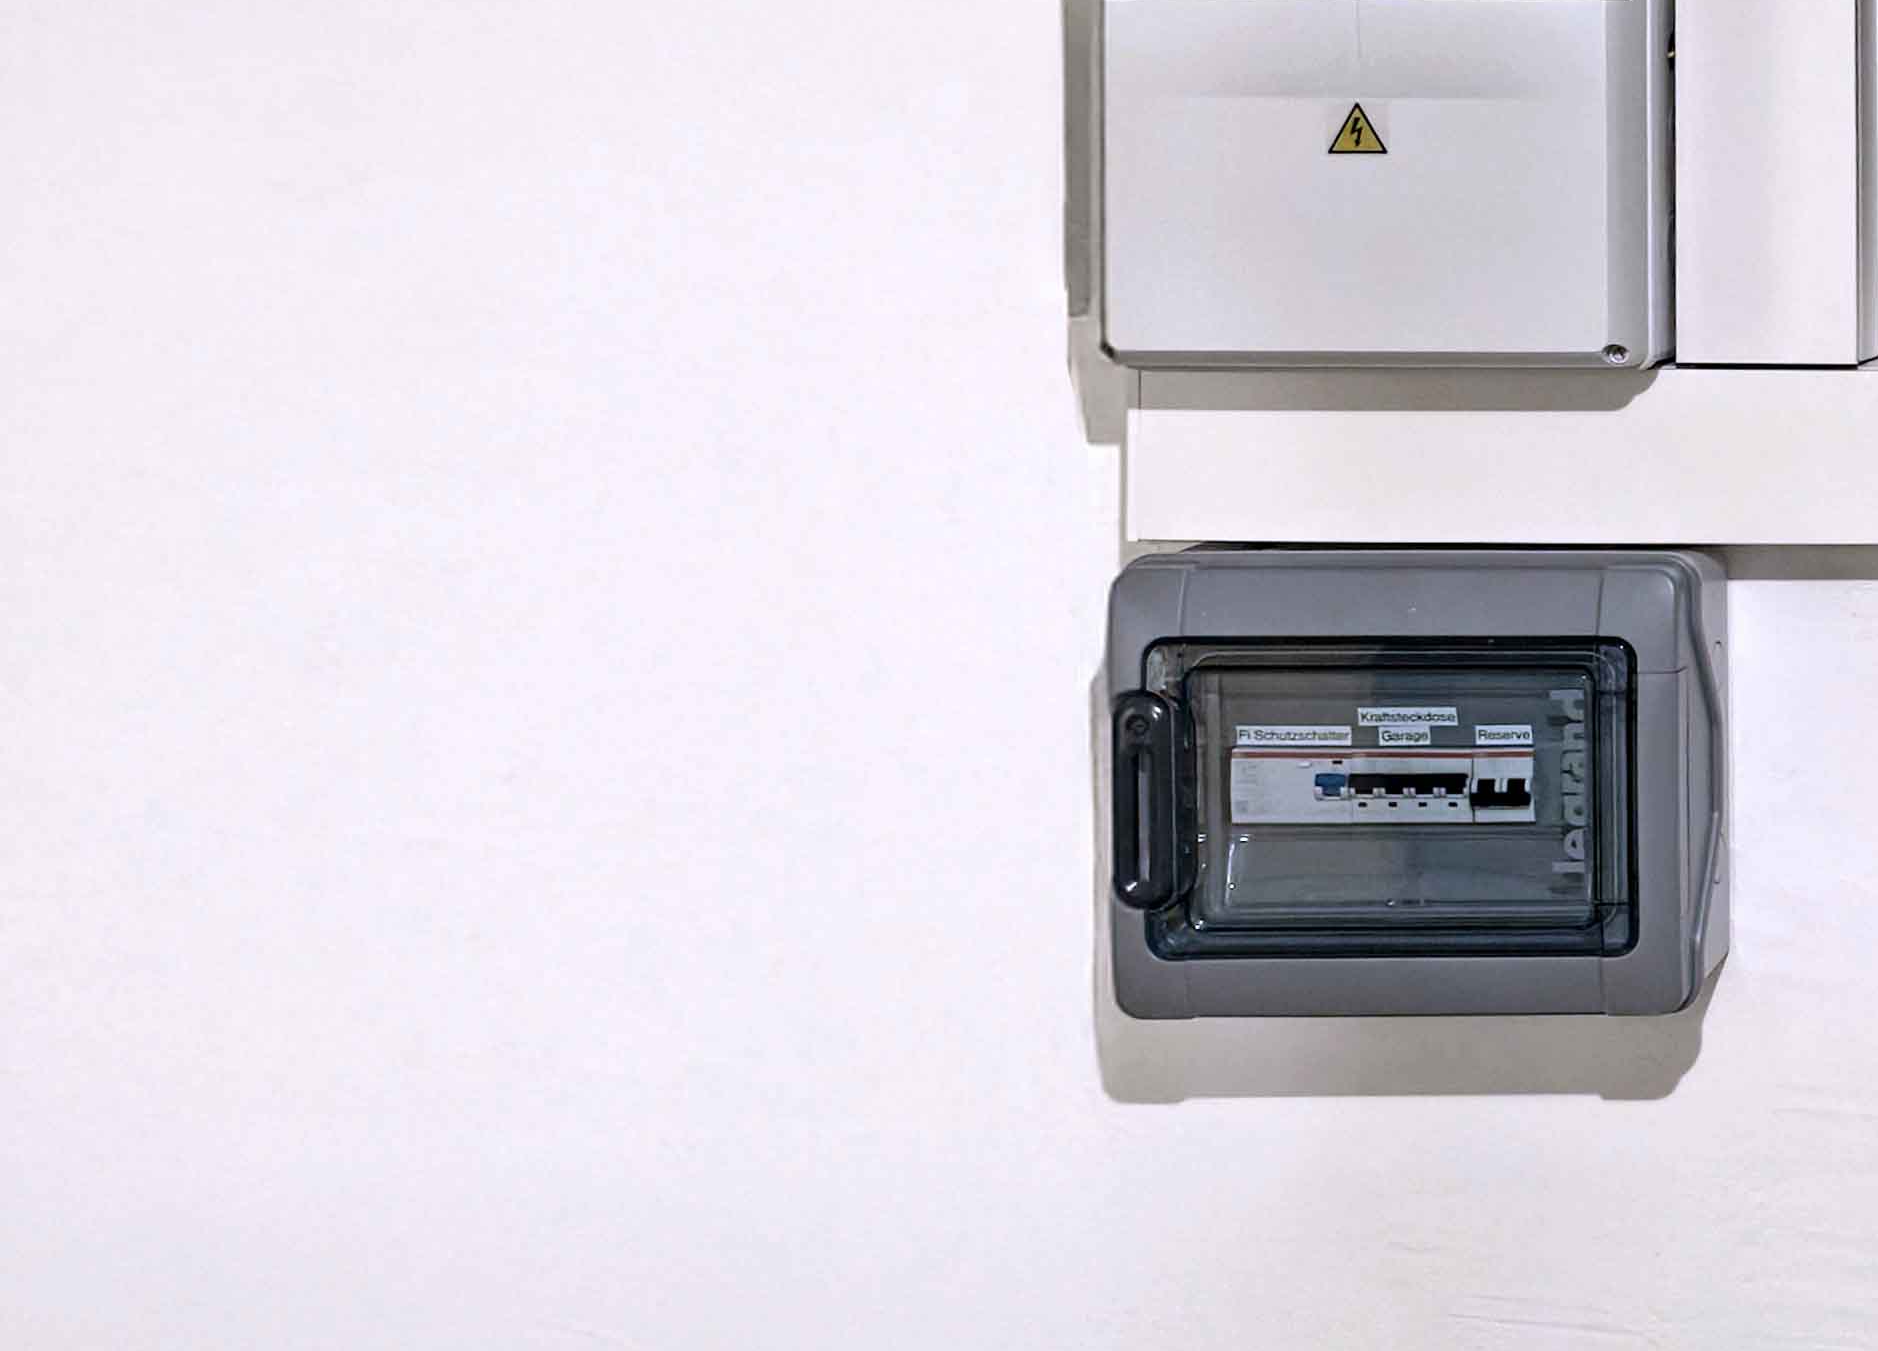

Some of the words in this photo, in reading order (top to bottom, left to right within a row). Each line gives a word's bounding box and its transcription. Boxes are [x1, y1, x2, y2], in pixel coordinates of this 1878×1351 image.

[1360, 711, 1456, 723] Kraftsteckdose
[1381, 729, 1428, 742] Garage
[1478, 729, 1530, 741] Reserve
